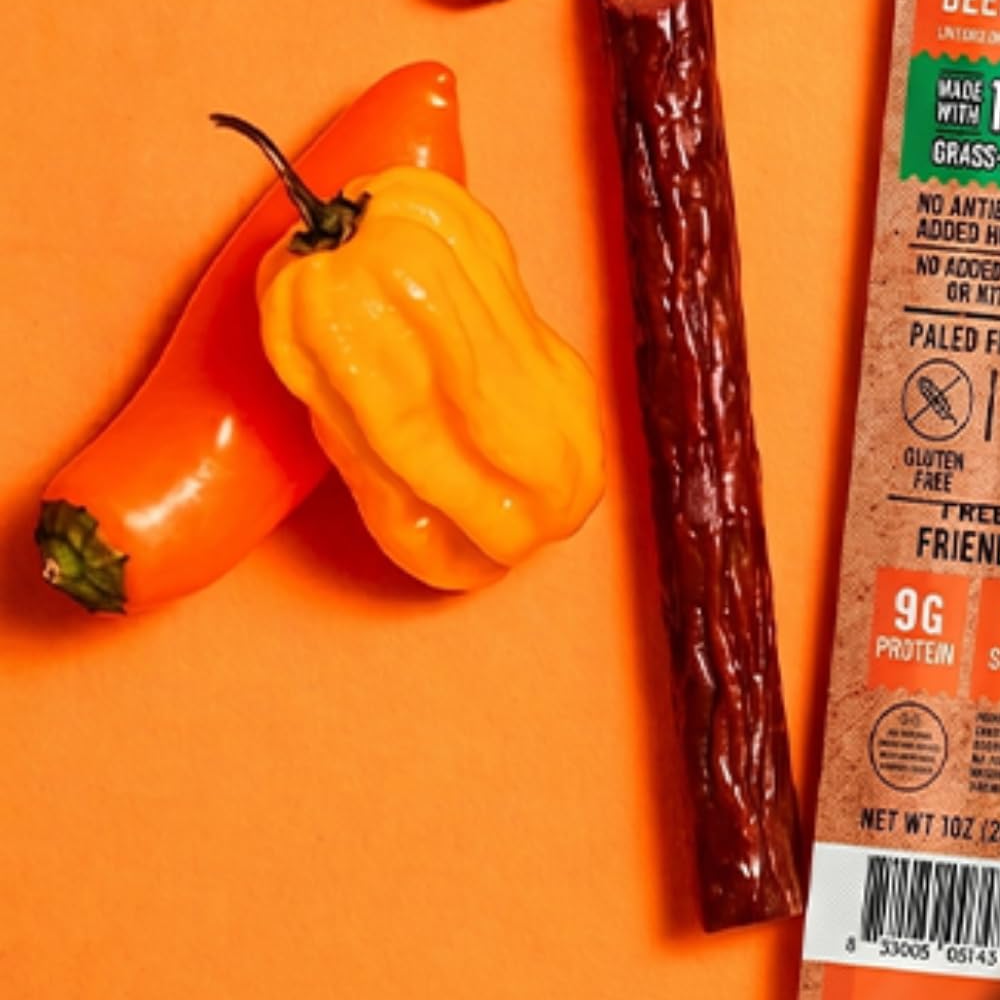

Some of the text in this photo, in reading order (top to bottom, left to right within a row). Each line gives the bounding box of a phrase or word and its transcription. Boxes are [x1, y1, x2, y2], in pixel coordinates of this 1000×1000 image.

[937, 78, 983, 103] MADE
[936, 102, 980, 125] WITH
[917, 193, 944, 216] NO
[917, 218, 979, 244] ADDED
[916, 254, 940, 275] NO
[947, 281, 970, 303] OR
[904, 446, 964, 471] GLUTEN
[913, 471, 953, 492] FREE
[894, 587, 944, 635] 9G
[875, 636, 955, 666] PROTEIN
[860, 808, 898, 832] NET
[904, 812, 934, 835] WT
